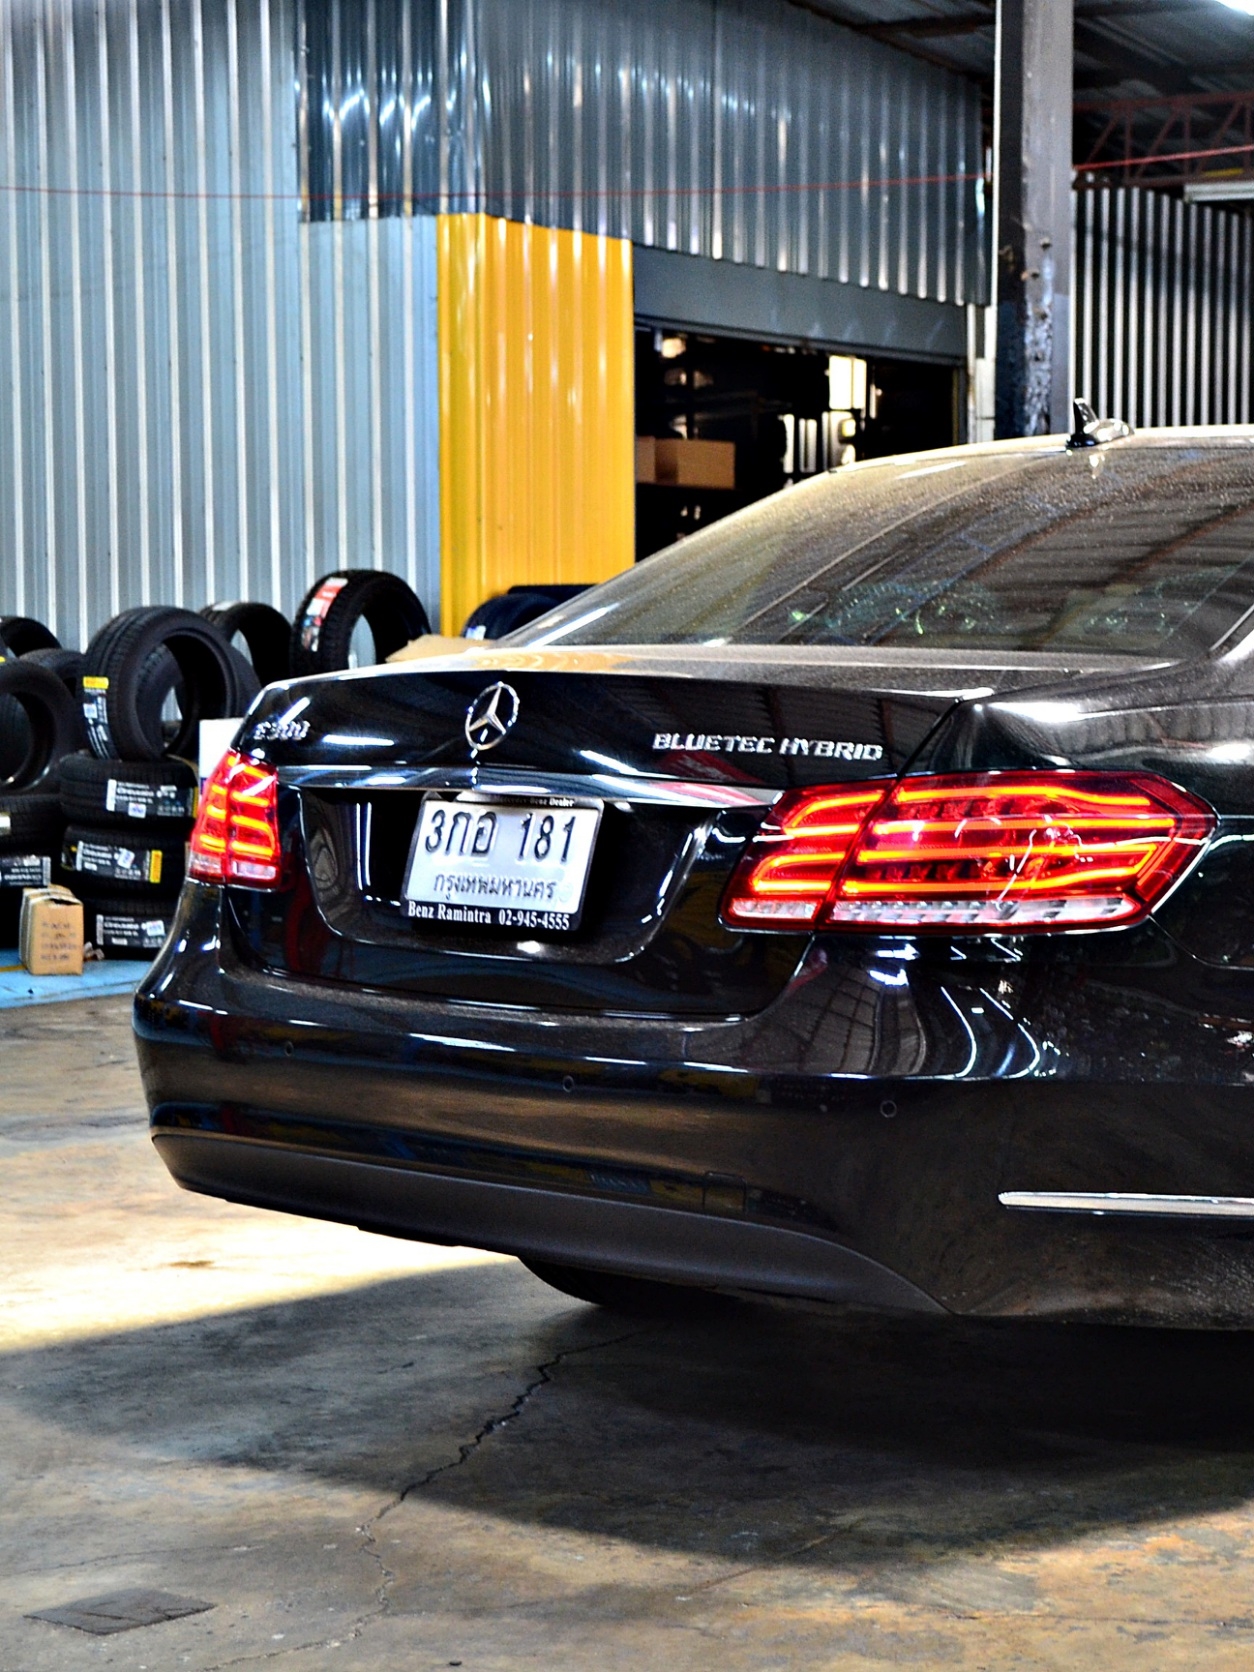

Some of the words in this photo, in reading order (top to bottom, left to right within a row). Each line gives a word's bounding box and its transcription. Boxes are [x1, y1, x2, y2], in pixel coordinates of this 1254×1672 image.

[652, 732, 775, 754] BLUETEC
[779, 737, 883, 761] HYBRID
[425, 809, 497, 857] 3กอ
[518, 813, 576, 863] 181
[433, 872, 558, 900] กรุงเทพมหานคร
[408, 900, 434, 918] Benz
[437, 903, 492, 924] Ramintra
[499, 909, 570, 931] 02-945-4555
